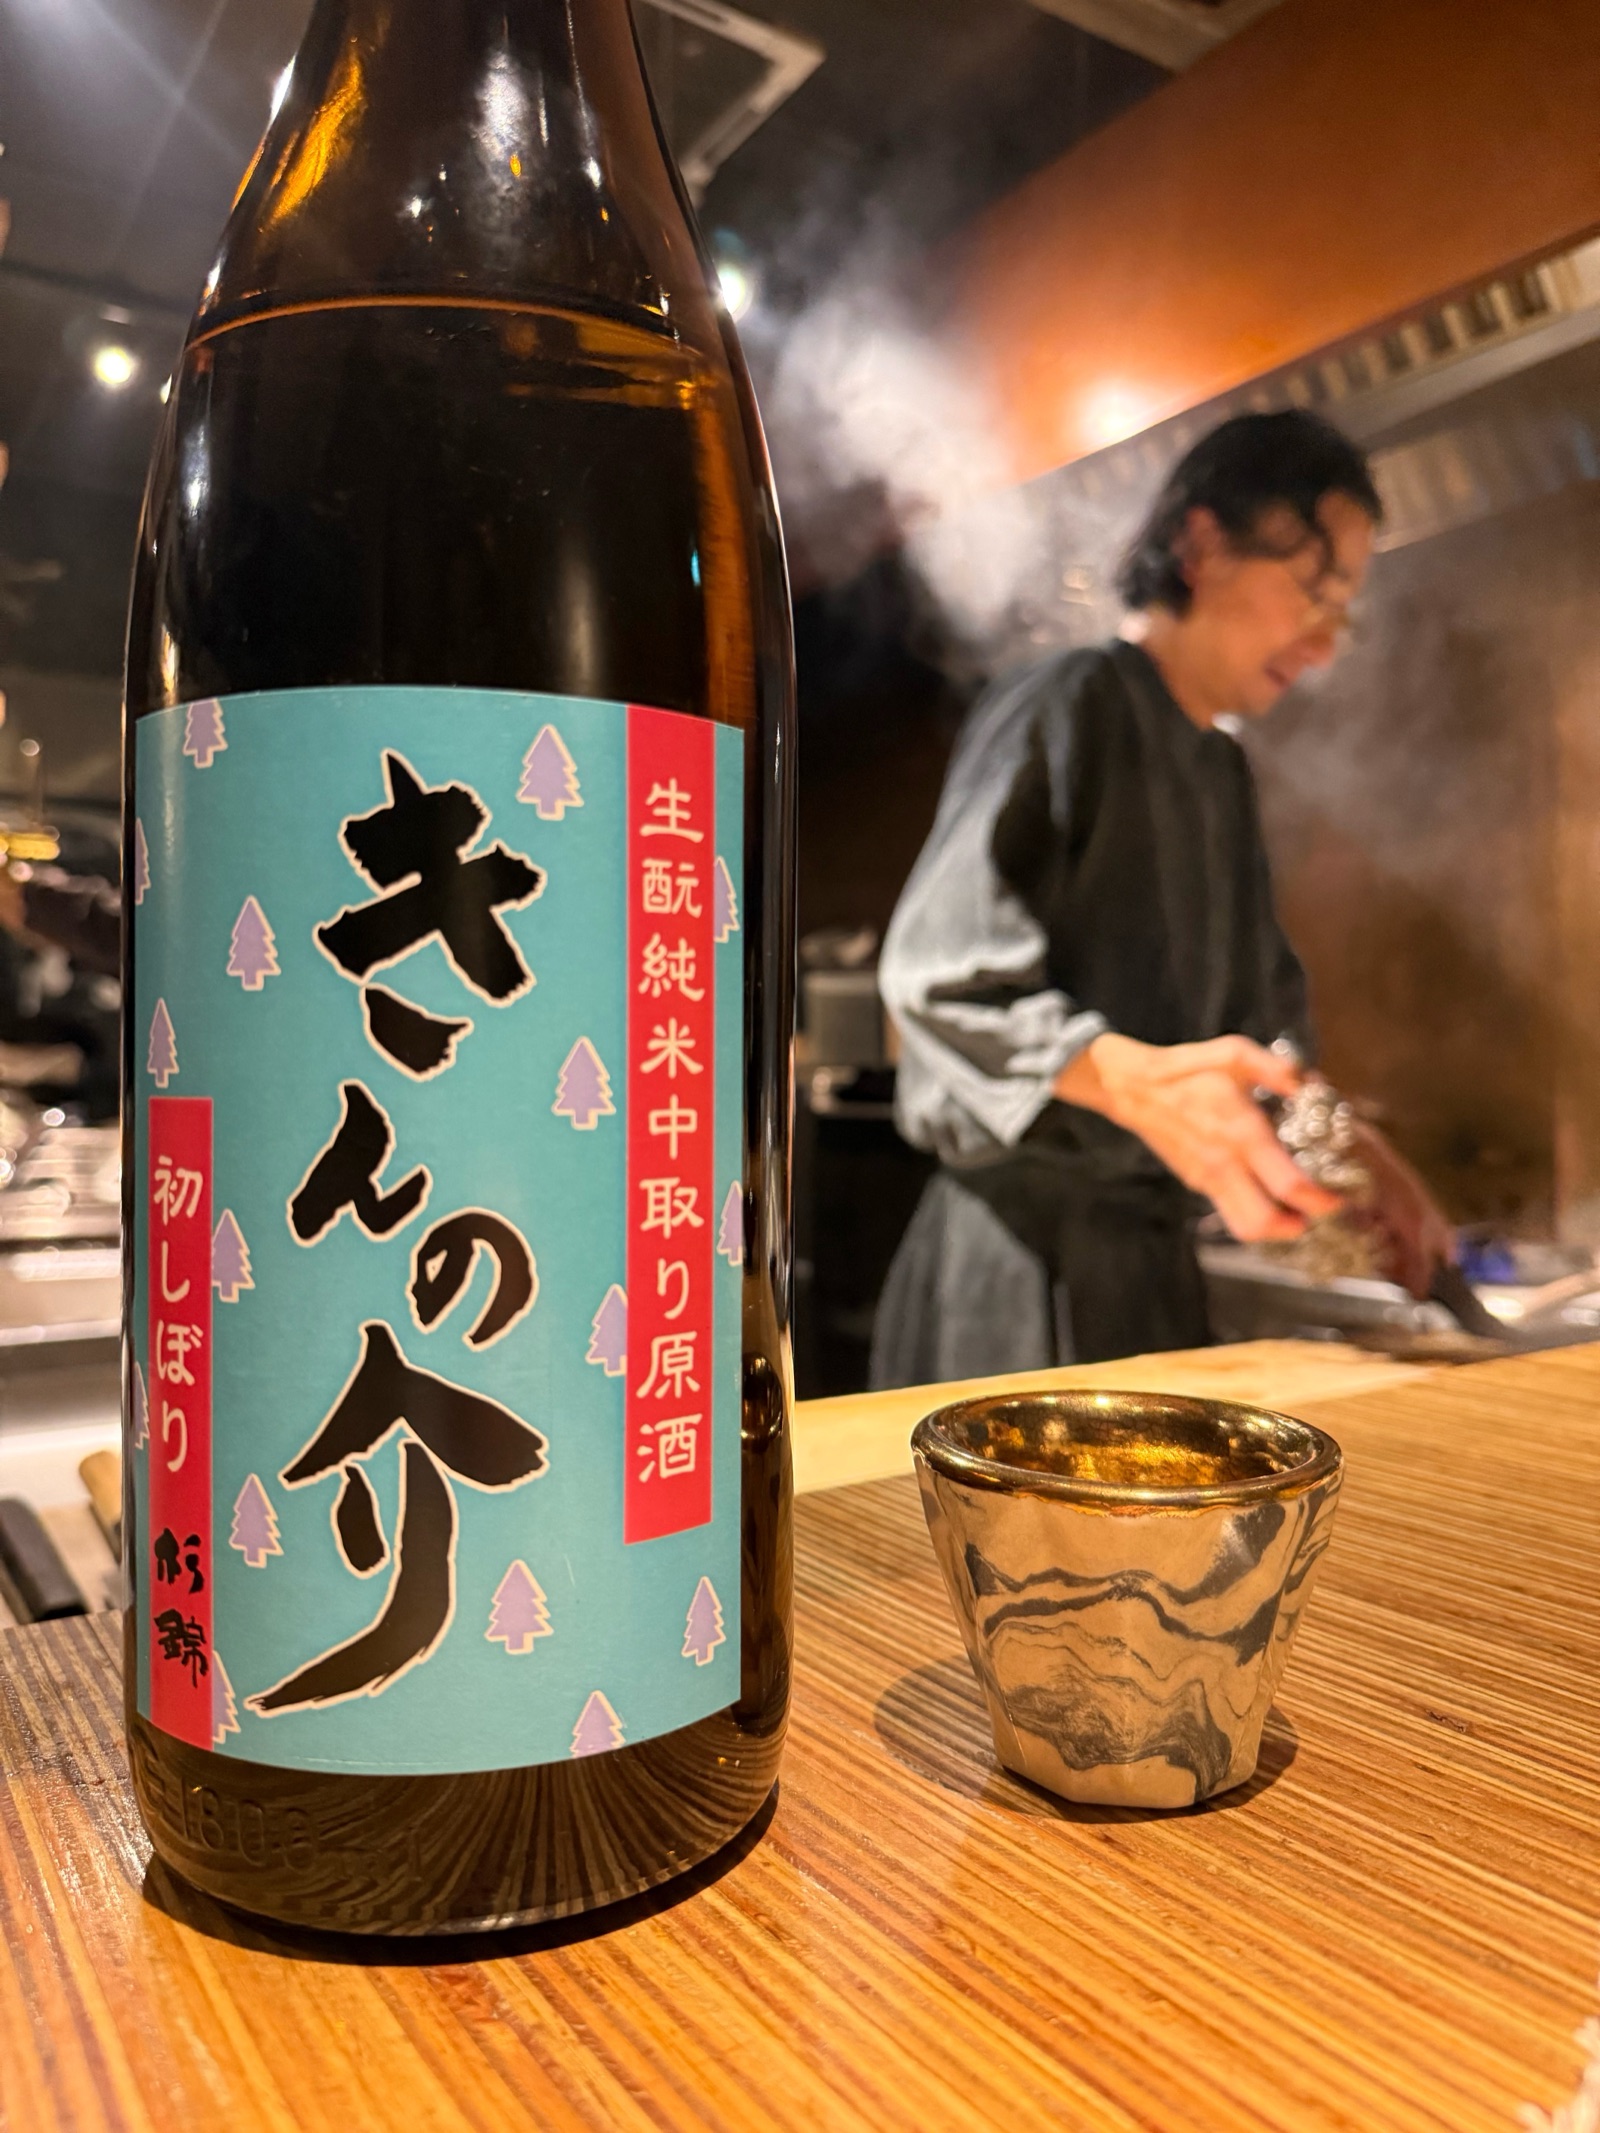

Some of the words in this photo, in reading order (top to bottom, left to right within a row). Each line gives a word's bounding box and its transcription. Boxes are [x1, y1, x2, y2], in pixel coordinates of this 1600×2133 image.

[153, 1155, 204, 1472] 初しぼり
[636, 778, 705, 1483] 生酛純米中取り原酒
